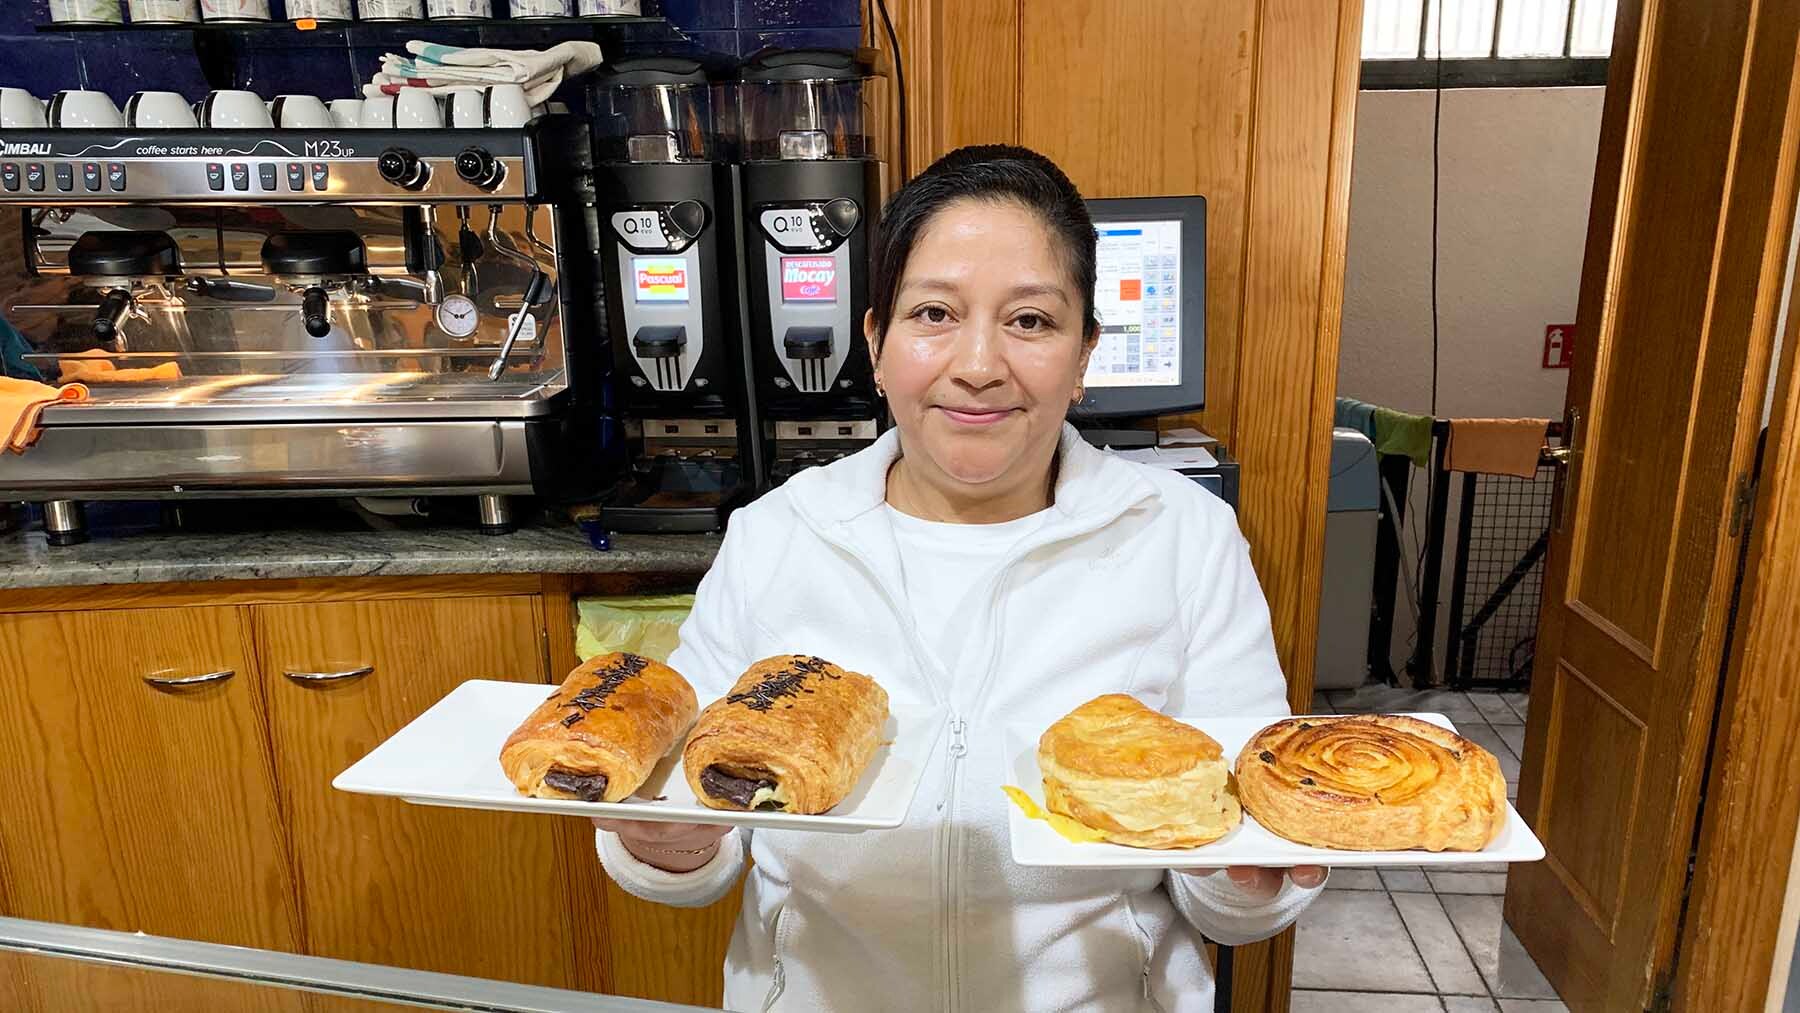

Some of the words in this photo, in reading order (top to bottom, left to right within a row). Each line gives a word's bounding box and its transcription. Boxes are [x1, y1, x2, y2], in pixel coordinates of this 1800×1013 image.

[136, 146, 167, 155] coffee
[170, 146, 198, 155] starts
[201, 146, 223, 155] here
[623, 217, 639, 234] Q
[640, 217, 652, 228] 10
[773, 216, 789, 232] Q
[790, 215, 803, 227] 10
[639, 272, 683, 285] Pascual
[783, 268, 835, 287] Mocay
